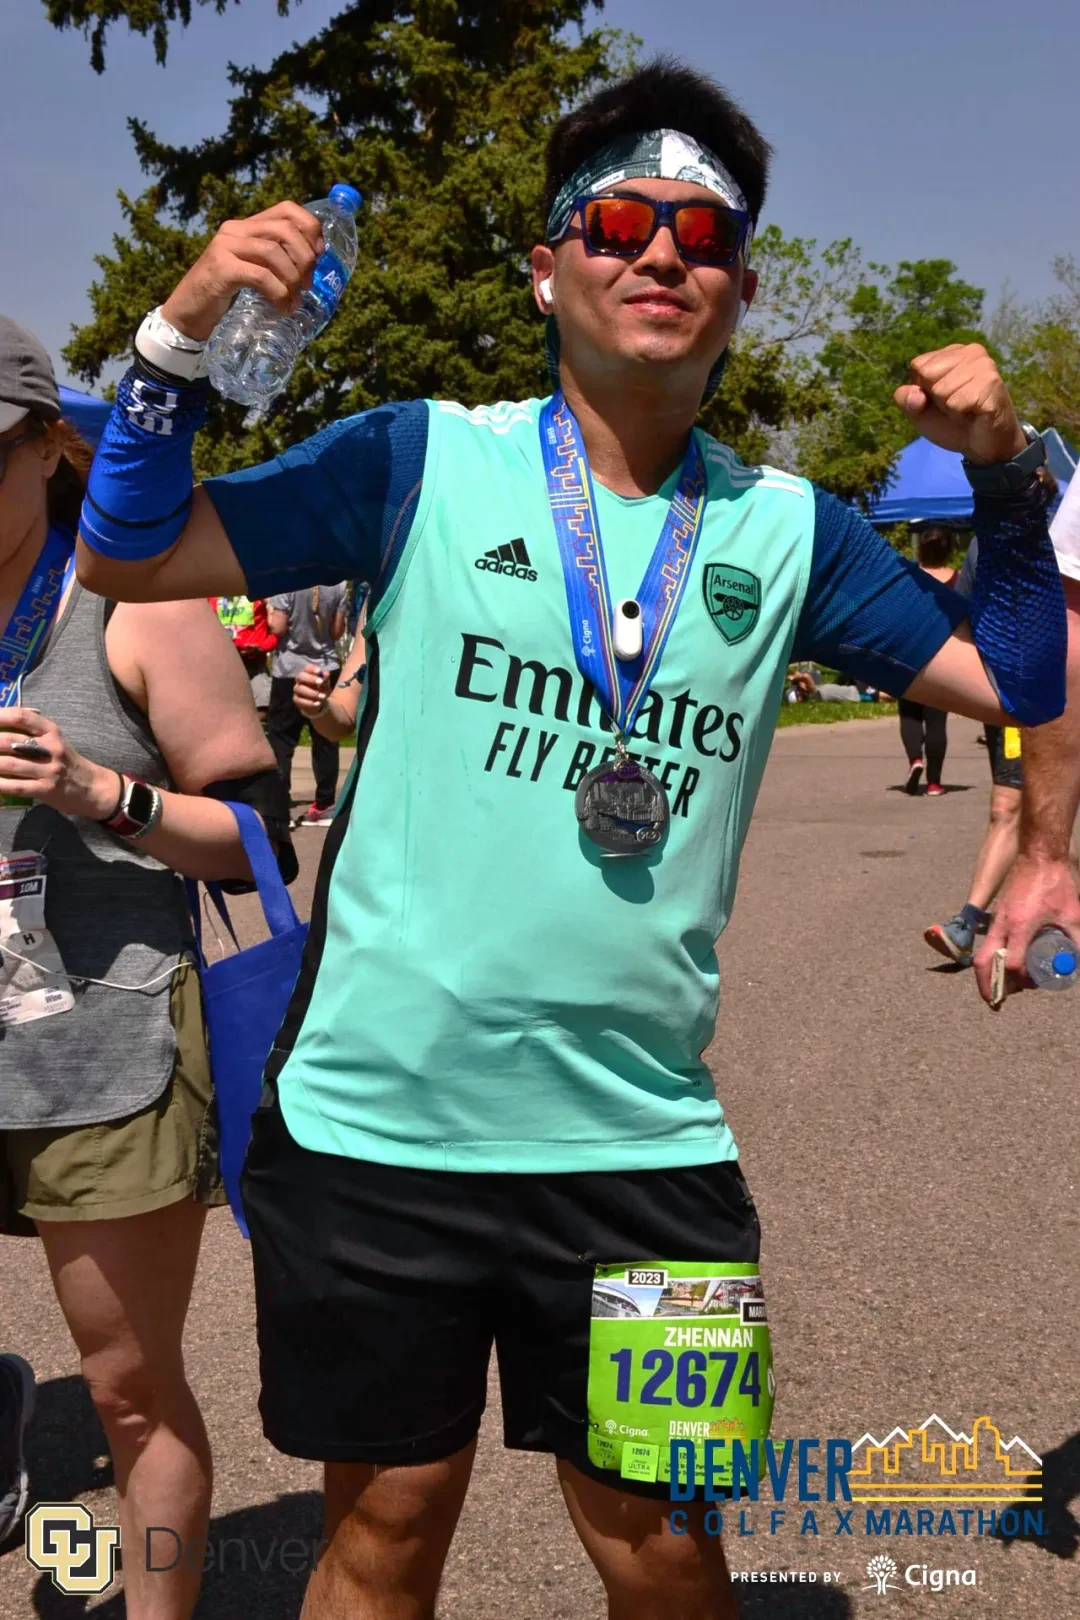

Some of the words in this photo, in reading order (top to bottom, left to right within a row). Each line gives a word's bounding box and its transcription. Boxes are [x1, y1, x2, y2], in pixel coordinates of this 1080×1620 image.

[475, 557, 538, 582] adidas
[713, 573, 754, 595] Arsenal
[582, 619, 593, 644] Cigna
[454, 632, 745, 764] Emiates
[484, 721, 559, 782] FLY
[562, 740, 701, 819] BER
[23, 932, 36, 946] H
[631, 1272, 661, 1284] 2023
[664, 1327, 754, 1348] ZHENNAN
[609, 1348, 761, 1408] 12674
[619, 1425, 648, 1437] Cigna
[669, 1420, 710, 1437] DENVER
